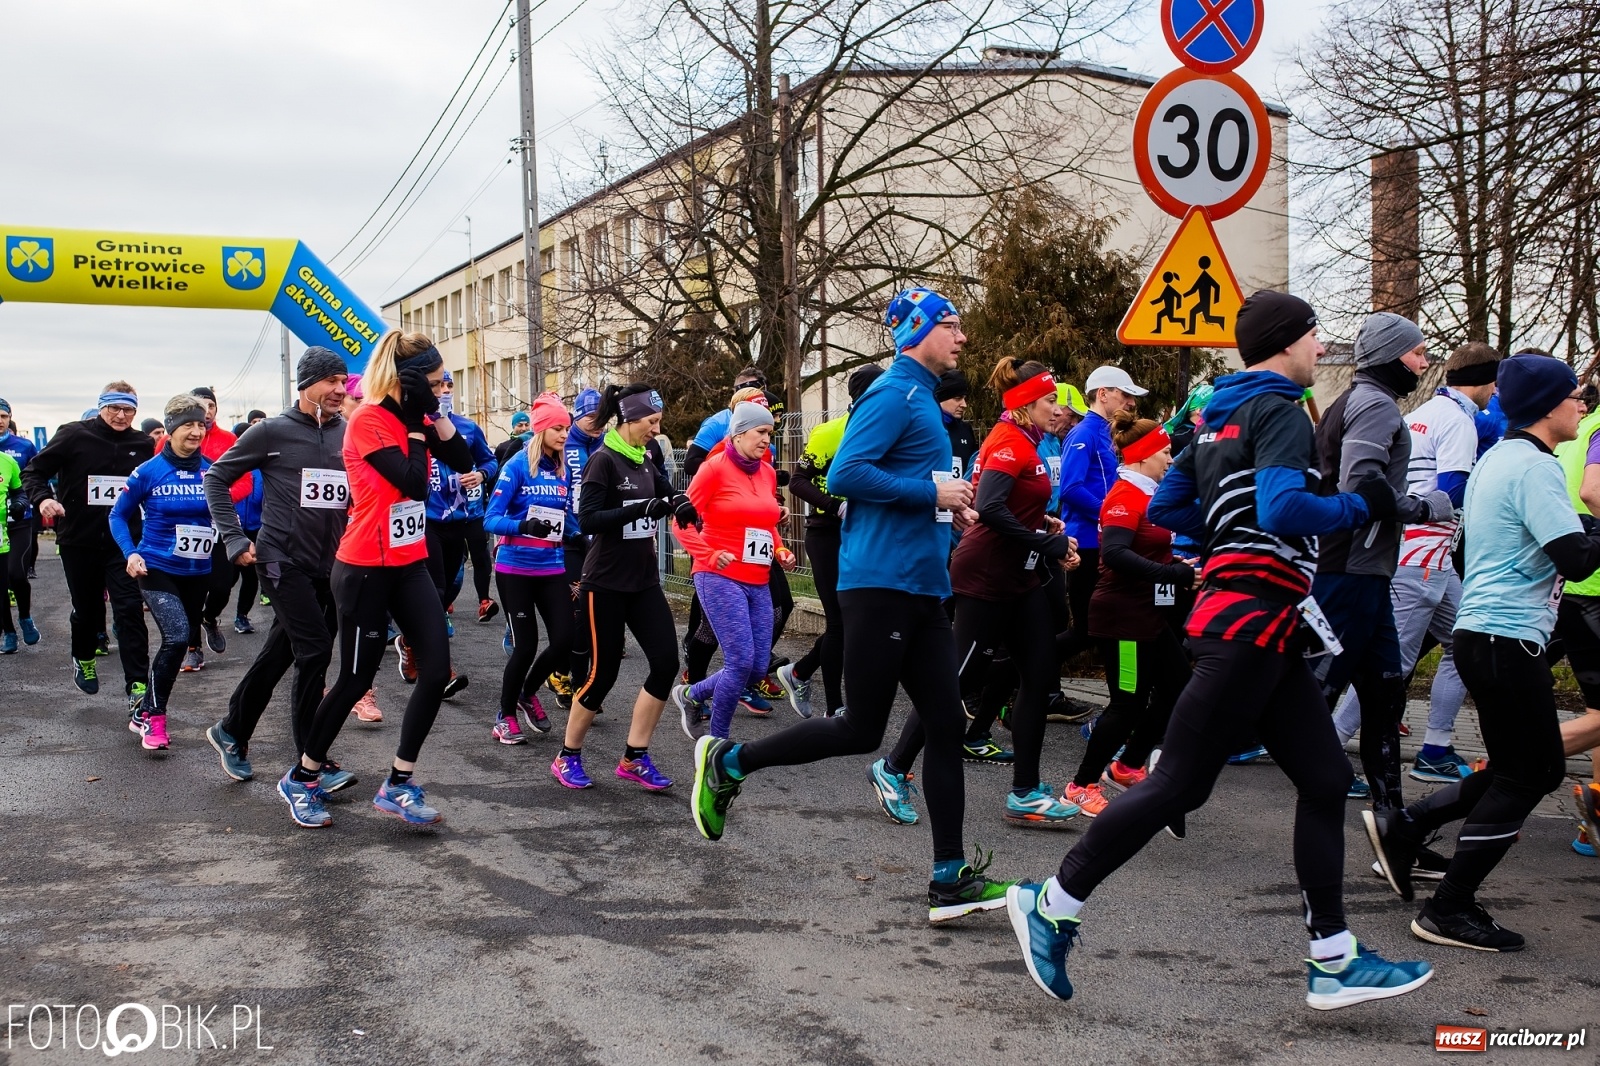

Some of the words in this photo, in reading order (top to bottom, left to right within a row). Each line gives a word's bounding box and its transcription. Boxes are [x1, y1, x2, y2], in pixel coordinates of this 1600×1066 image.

[1157, 103, 1250, 182] 30
[96, 240, 182, 255] Gmina
[73, 254, 206, 275] Pietrowice
[91, 274, 188, 291] Wielkie
[298, 265, 343, 311] Gmina
[341, 306, 380, 344] ludzi
[284, 283, 363, 356] aktywnych
[305, 482, 347, 501] 389
[392, 512, 424, 538] 394
[178, 537, 212, 554] 370
